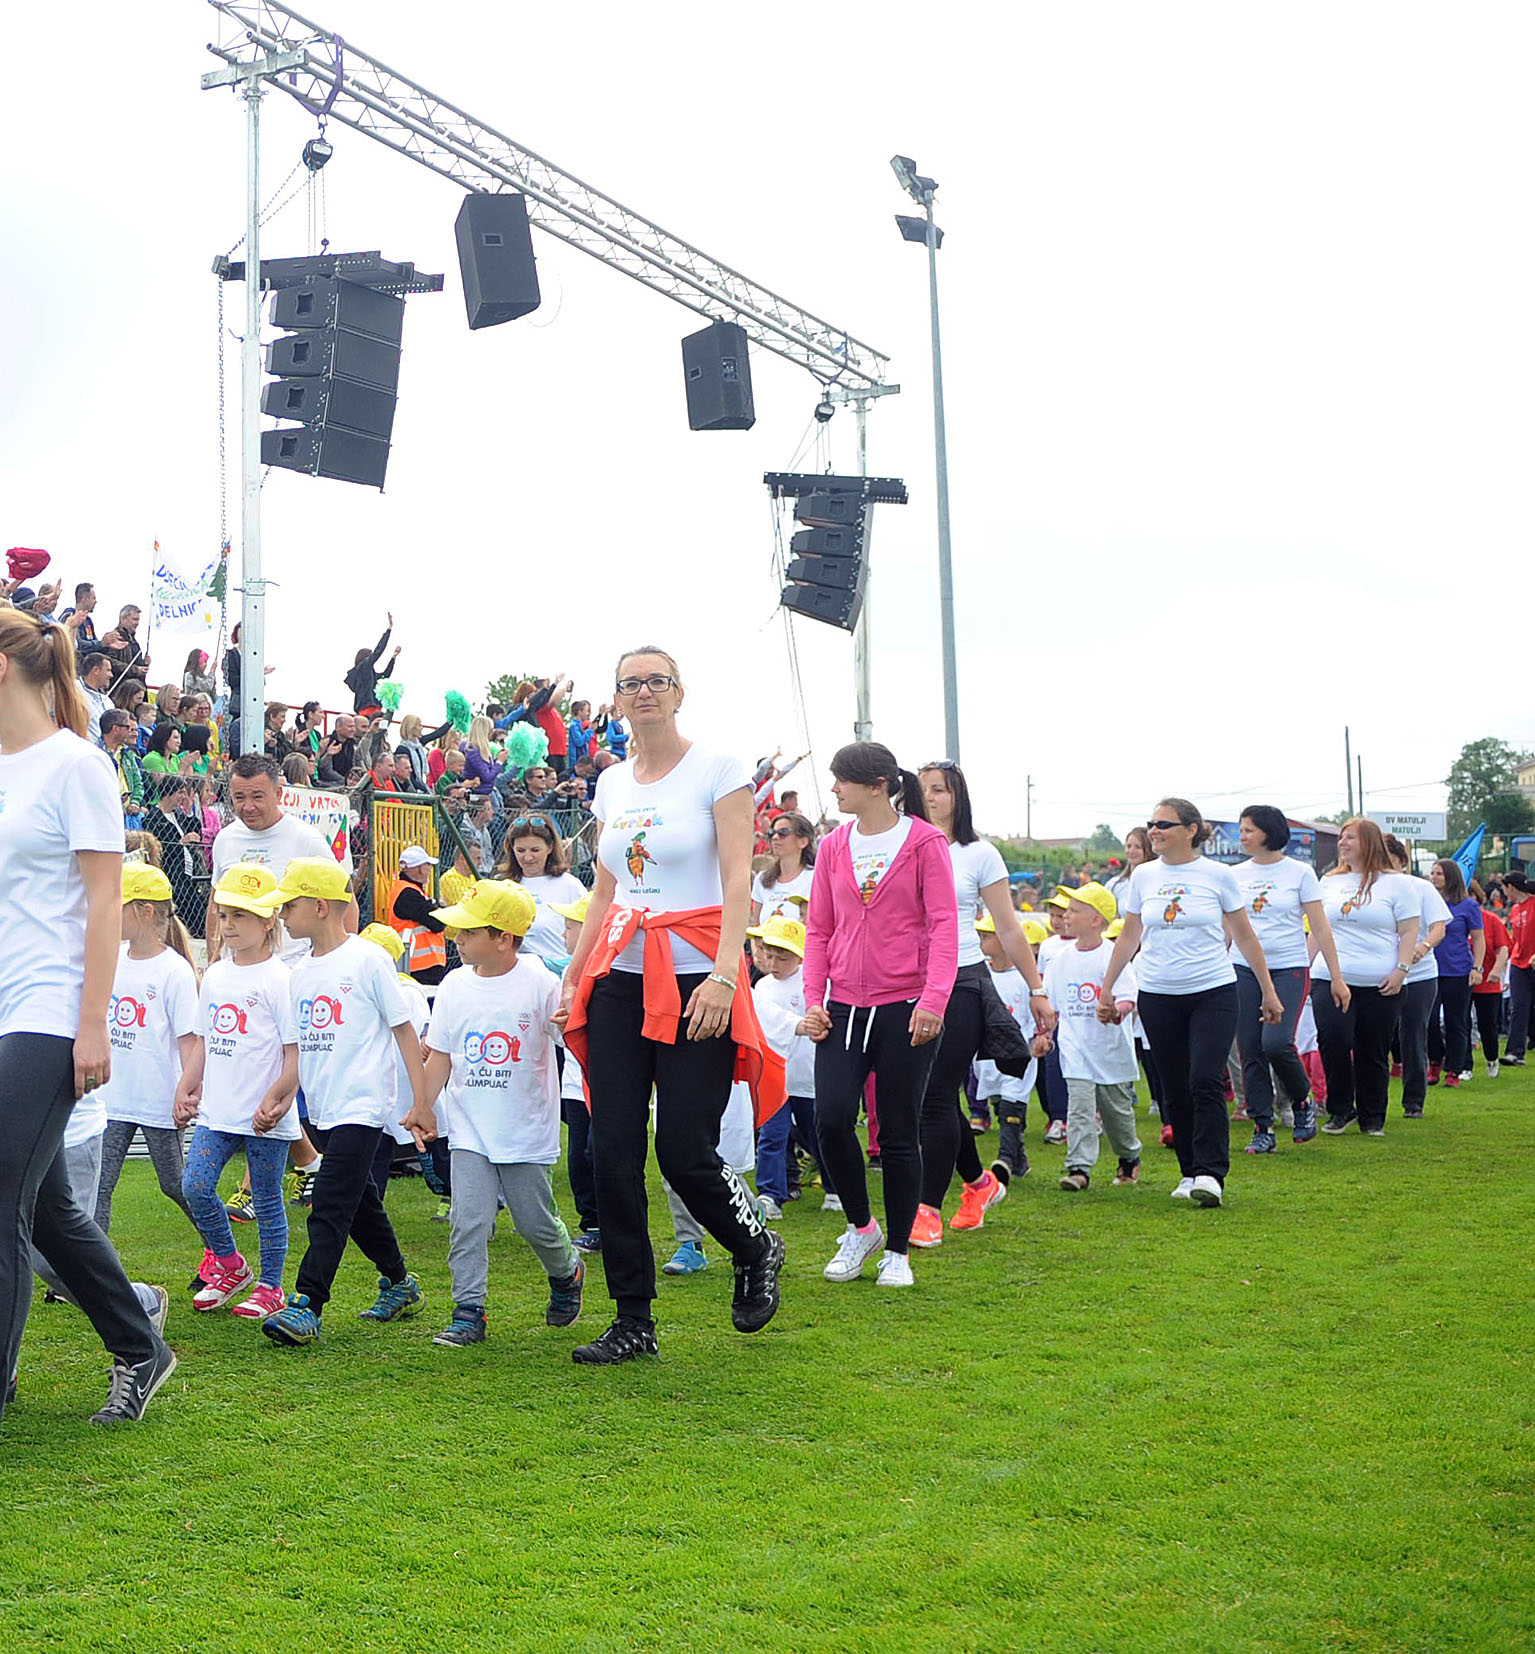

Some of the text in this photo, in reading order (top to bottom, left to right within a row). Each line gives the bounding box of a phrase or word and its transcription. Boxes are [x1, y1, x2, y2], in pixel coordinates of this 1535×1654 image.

[1397, 816, 1426, 824] MATULJI
[478, 1066, 492, 1077] ĆU
[495, 1069, 512, 1078] BITI
[465, 1079, 508, 1089] LIMPIJAC
